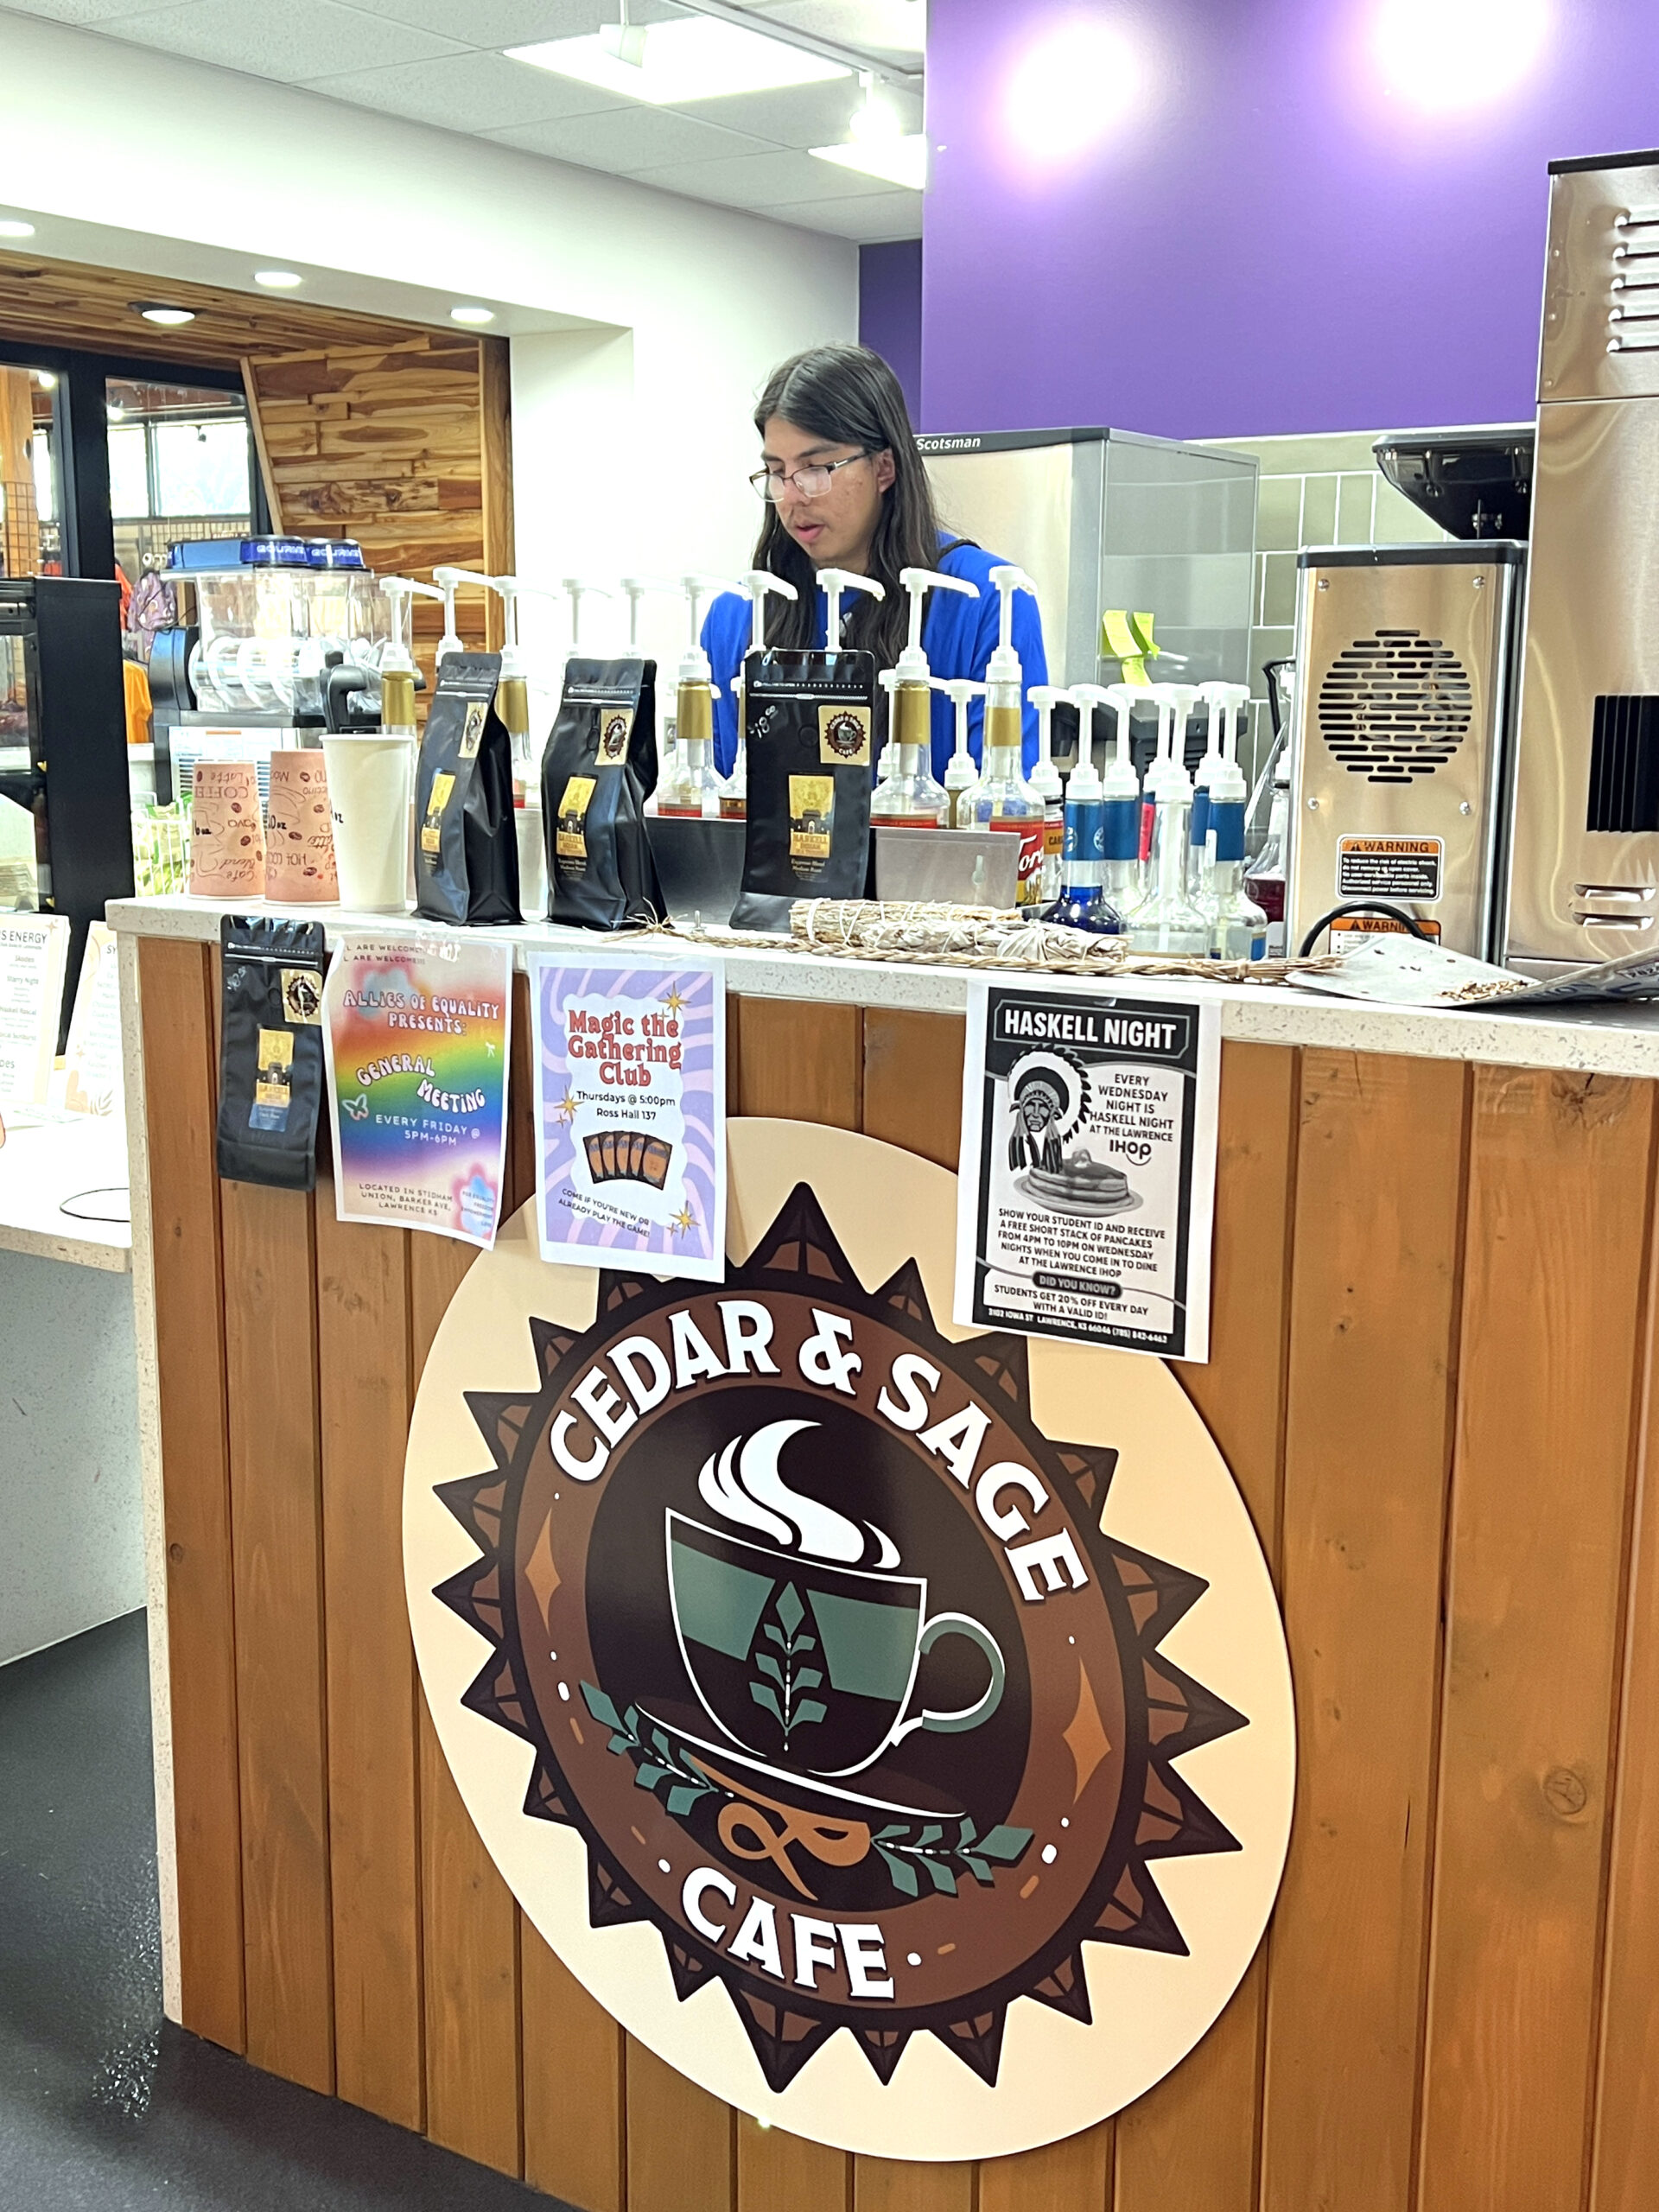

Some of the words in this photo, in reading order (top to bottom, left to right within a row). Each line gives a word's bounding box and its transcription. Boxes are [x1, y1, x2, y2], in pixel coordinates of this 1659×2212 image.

[916, 437, 981, 449] Scotsman
[1363, 842, 1428, 852] WARNING
[10, 931, 47, 944] ENERGY
[343, 990, 405, 1008] ALLIES
[410, 995, 426, 1011] OF
[431, 996, 500, 1020] EQUALITY
[568, 1009, 635, 1039] Magic
[641, 1013, 679, 1038] the
[1004, 1009, 1098, 1042] HASKELL
[1104, 1019, 1177, 1050] NIGHT
[568, 1033, 682, 1071] Gathering
[356, 1053, 436, 1087] GENERAL
[599, 1062, 652, 1087] Club
[1115, 1073, 1150, 1086] EVERY
[416, 1077, 486, 1114] MEETING
[576, 1091, 626, 1104] Thursdays
[627, 1095, 638, 1105] @
[639, 1095, 676, 1108] 5:00pm
[1098, 1085, 1168, 1102] WEDNESDAY
[597, 1108, 619, 1118] Ross
[621, 1110, 639, 1120] Hall
[642, 1111, 656, 1121] 137
[1105, 1099, 1141, 1114] NIGHT
[1144, 1103, 1154, 1114] IS
[375, 1114, 417, 1127] EVERY
[423, 1120, 467, 1135] FRIDAY
[470, 1128, 480, 1139] @
[1090, 1111, 1136, 1126] HASKELL
[1139, 1116, 1174, 1129] NIGHT
[404, 1129, 457, 1146] 5PM-6PM
[1089, 1125, 1102, 1135] AT
[1103, 1126, 1121, 1136] THE
[1122, 1128, 1173, 1142] LAWRENCE
[359, 1183, 400, 1193] LOCATED
[417, 1190, 453, 1202] STIDHAM
[360, 1192, 396, 1202] UNION,
[399, 1196, 432, 1206] BARKER
[378, 1202, 425, 1214] LAWRENCE
[558, 1198, 591, 1217] ALREADY
[593, 1210, 611, 1222] PLAY
[612, 1217, 626, 1229] THE
[562, 1188, 583, 1202] COME
[593, 1199, 618, 1215] YOU'RE
[620, 1210, 638, 1222] NEW
[639, 1217, 650, 1226] OR
[998, 1208, 1025, 1220] SHOW
[1026, 1211, 1050, 1224] YOUR
[1052, 1216, 1092, 1230] STUDENT
[1094, 1220, 1103, 1231] ID
[1105, 1223, 1125, 1234] AND
[1127, 1226, 1166, 1239] RECEIVE
[1000, 1220, 1006, 1229] A
[1007, 1221, 1027, 1232] FREE
[1029, 1224, 1058, 1236] SHORT
[1059, 1228, 1088, 1241] STACK
[1090, 1232, 1102, 1242] OF
[1103, 1234, 1153, 1249] PANCAKES
[998, 1230, 1021, 1242] FROM
[1023, 1233, 1041, 1244] 4PM
[1043, 1236, 1055, 1246] TO
[1057, 1239, 1080, 1250] 10PM
[1082, 1242, 1095, 1252] ON
[1096, 1245, 1154, 1260] WEDNESDAY
[1001, 1242, 1032, 1254] NIGHTS
[1033, 1246, 1060, 1259] WHEN
[1062, 1250, 1082, 1262] YOU
[1083, 1254, 1108, 1265] COME
[1110, 1257, 1120, 1267] IN
[1122, 1259, 1134, 1268] TO
[1136, 1261, 1158, 1272] DINE
[1019, 1255, 1030, 1265] AT
[1032, 1257, 1048, 1268] THE
[1050, 1260, 1097, 1275] LAWRENCE
[1099, 1267, 1122, 1278] IHOP
[1039, 1274, 1057, 1287] DID
[1058, 1278, 1078, 1291] YOU
[1079, 1281, 1116, 1296] KNOW?
[994, 1284, 1038, 1300] STUDENTS
[1039, 1291, 1057, 1301] GET
[1058, 1294, 1078, 1306] 20%
[1080, 1297, 1097, 1308] OFF
[1099, 1300, 1128, 1313] EVERY
[1129, 1305, 1148, 1316] DAY
[1033, 1301, 1057, 1313] WITH
[1058, 1305, 1065, 1313] A
[1066, 1306, 1093, 1319] VALID
[1095, 1311, 1108, 1321] ID!
[1005, 1310, 1025, 1322] IOWA
[550, 1300, 780, 1483] CEDAR
[798, 1307, 863, 1396] &
[876, 1353, 1090, 1602] SAGE
[682, 1867, 894, 1999] CAFE
